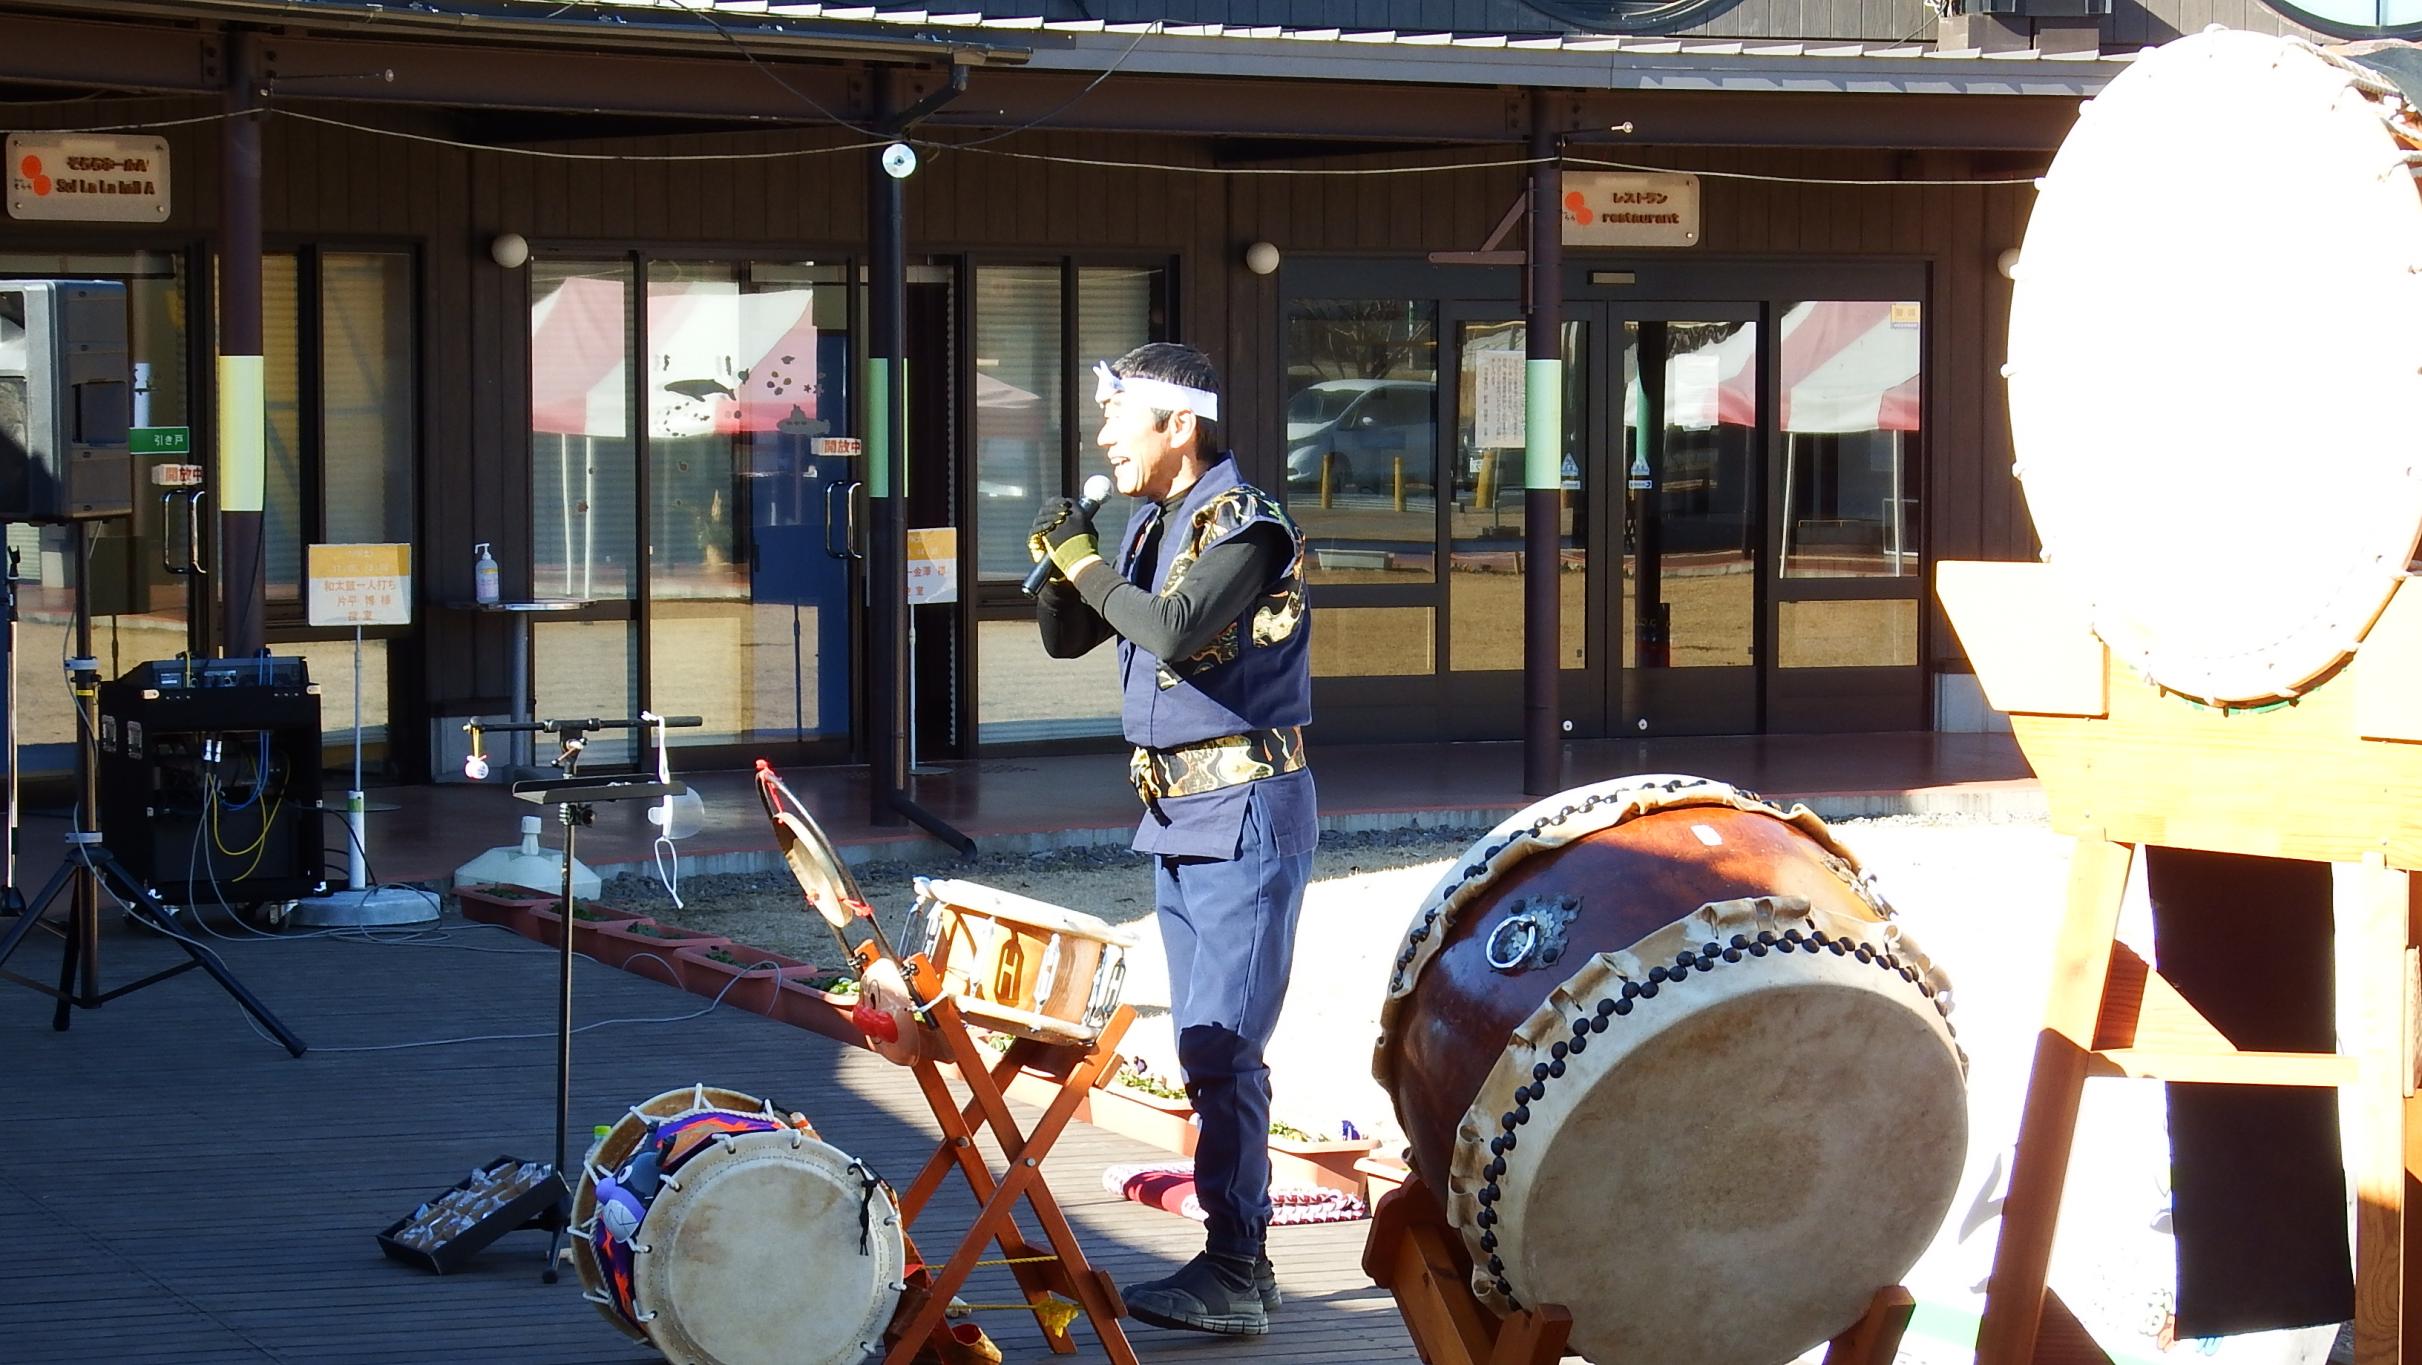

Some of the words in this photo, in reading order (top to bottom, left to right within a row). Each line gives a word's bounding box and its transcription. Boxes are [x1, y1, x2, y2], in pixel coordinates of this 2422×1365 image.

[144, 181, 155, 195] A
[1612, 192, 1668, 204] レストラン
[1602, 213, 1679, 224] restaurant
[154, 434, 184, 446] 引き戸
[825, 439, 860, 453] 開放中
[165, 467, 205, 482] 開放中
